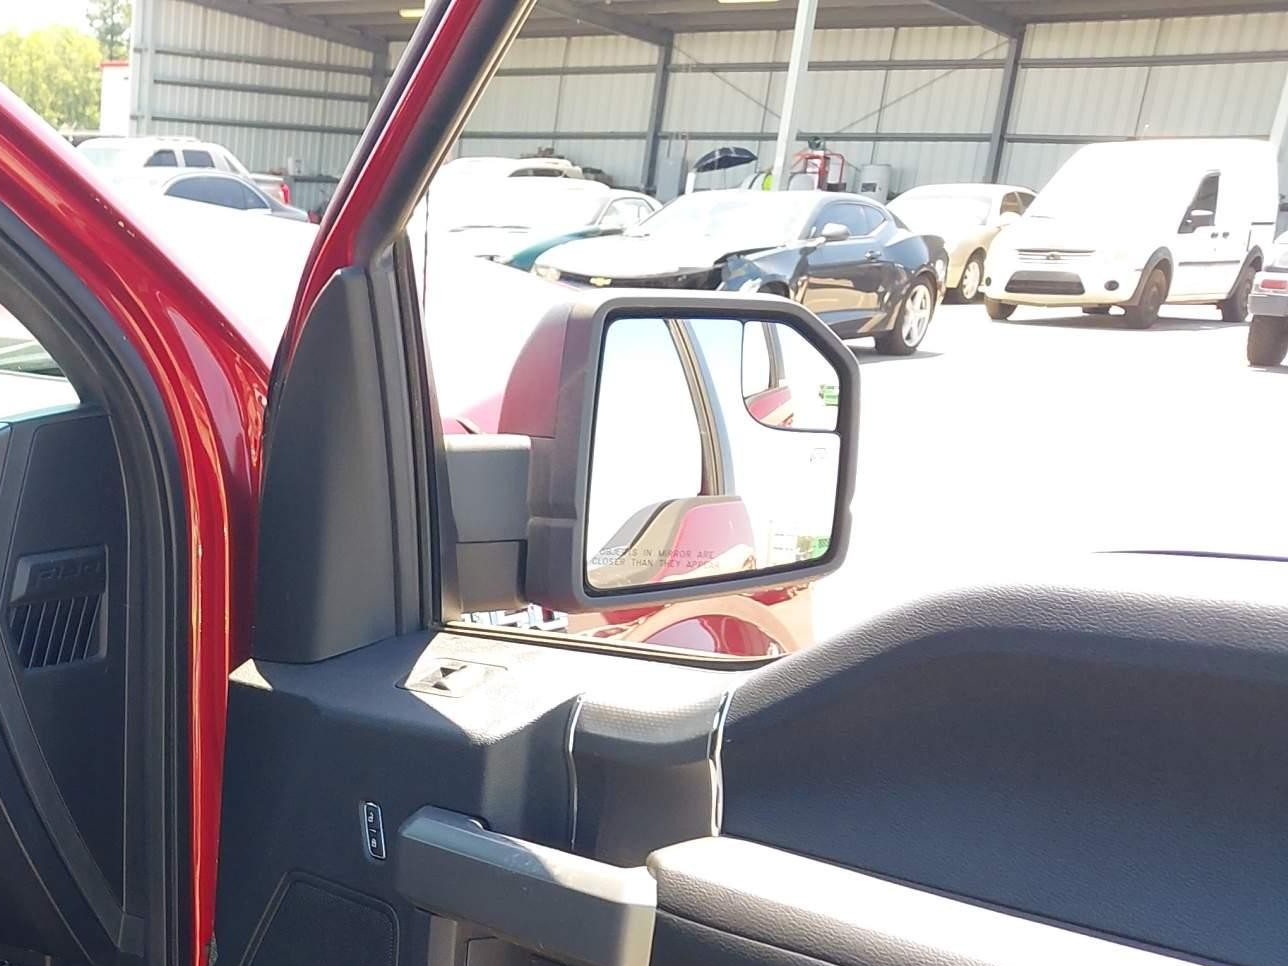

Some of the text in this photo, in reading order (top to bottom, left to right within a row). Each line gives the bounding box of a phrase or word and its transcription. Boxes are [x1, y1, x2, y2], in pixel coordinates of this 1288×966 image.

[599, 547, 715, 560] OBJES IN MIRROR ARE
[591, 556, 625, 566] CLOSER
[631, 557, 654, 568] THAN
[659, 559, 680, 569] THEY
